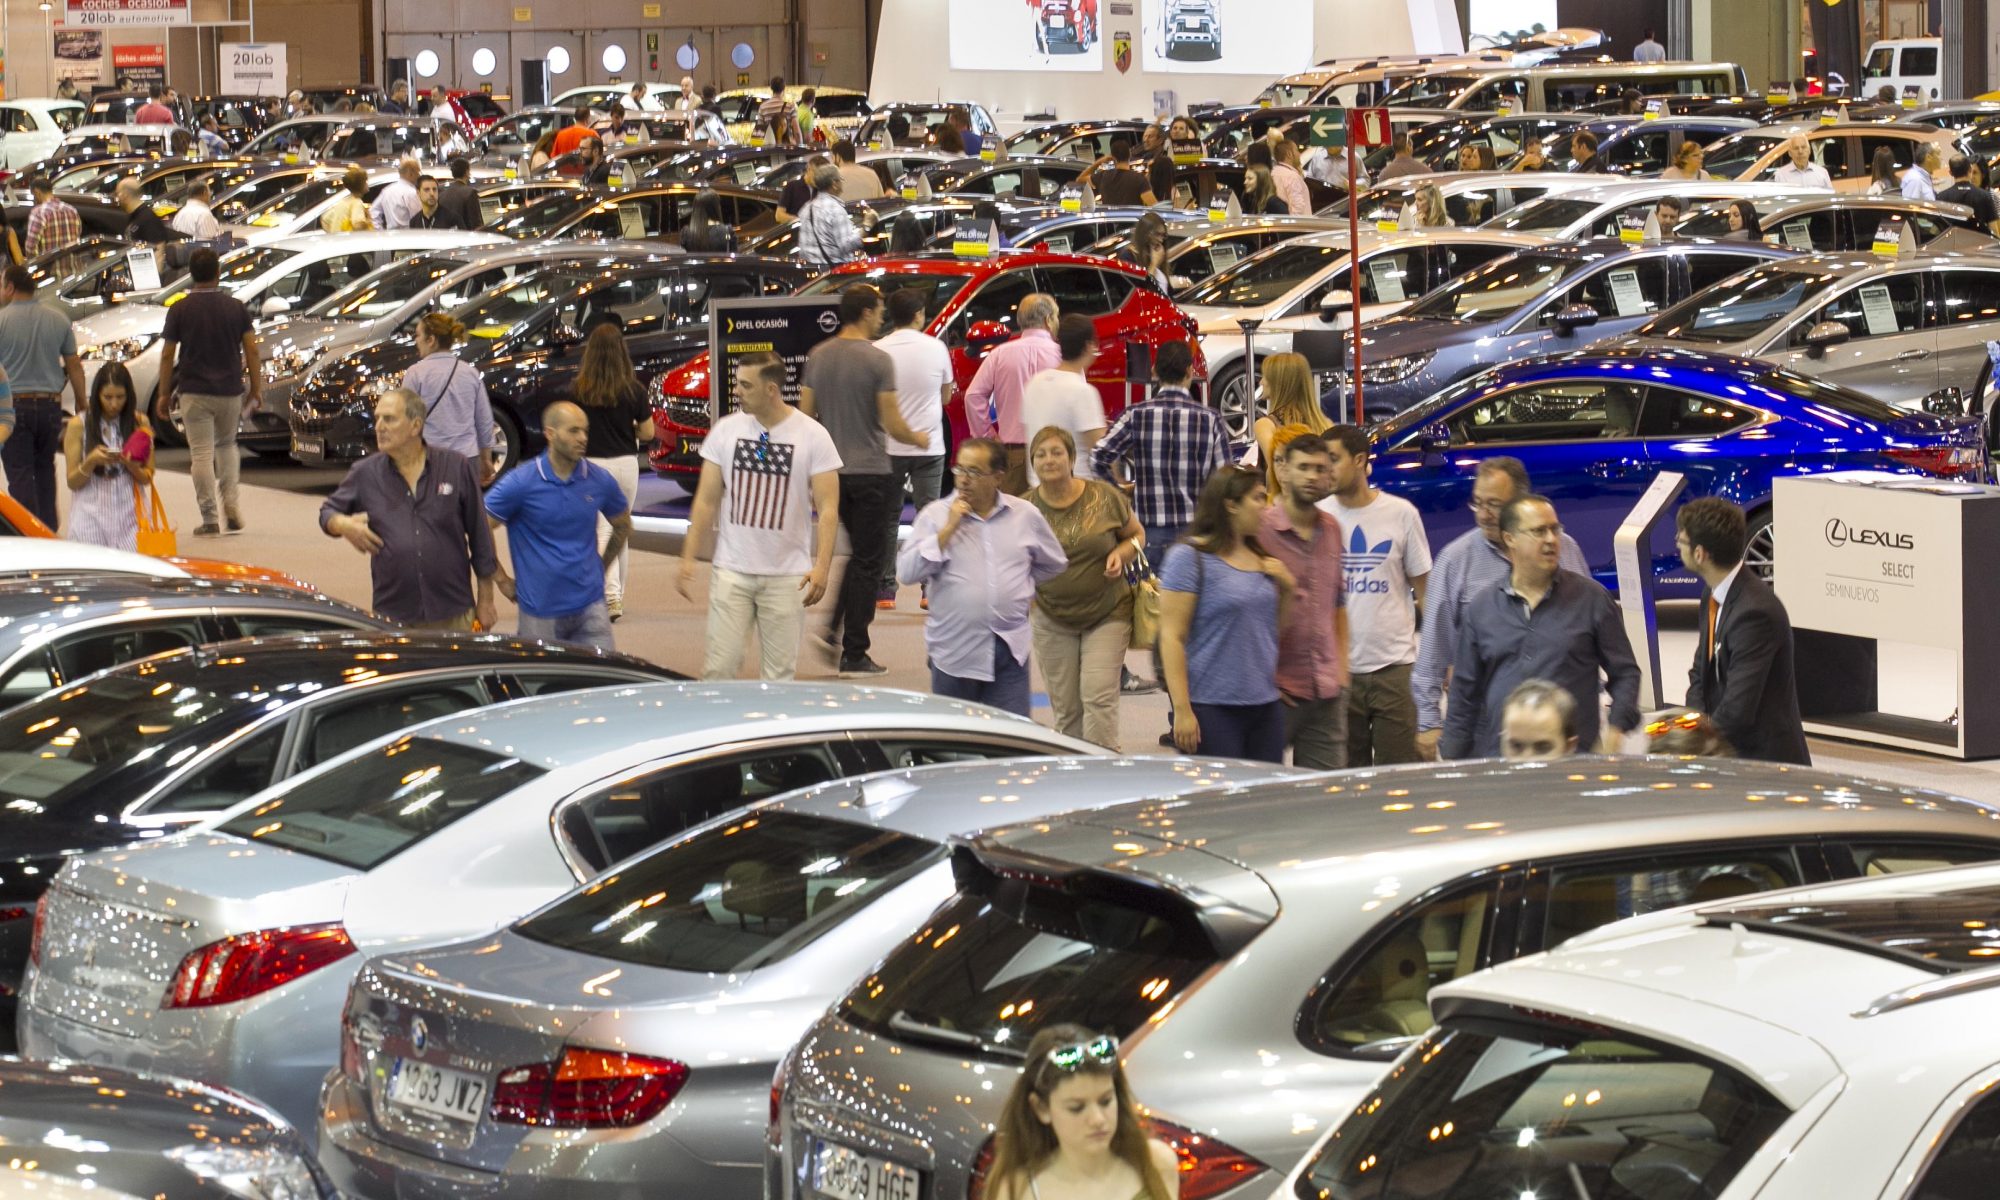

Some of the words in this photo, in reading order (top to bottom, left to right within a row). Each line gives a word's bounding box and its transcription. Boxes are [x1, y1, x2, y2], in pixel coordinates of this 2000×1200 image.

[82, 0, 120, 10] coches
[81, 11, 115, 24] 20lab
[119, 14, 175, 23] automotive
[233, 52, 273, 65] 20lab
[736, 320, 754, 330] OPEL
[755, 317, 788, 328] OCASIÓN
[1849, 527, 1914, 549] LEXUS
[1881, 561, 1915, 580] SELECT
[1825, 582, 1880, 604] SEMINUEVOS
[445, 1077, 483, 1116] JWZ
